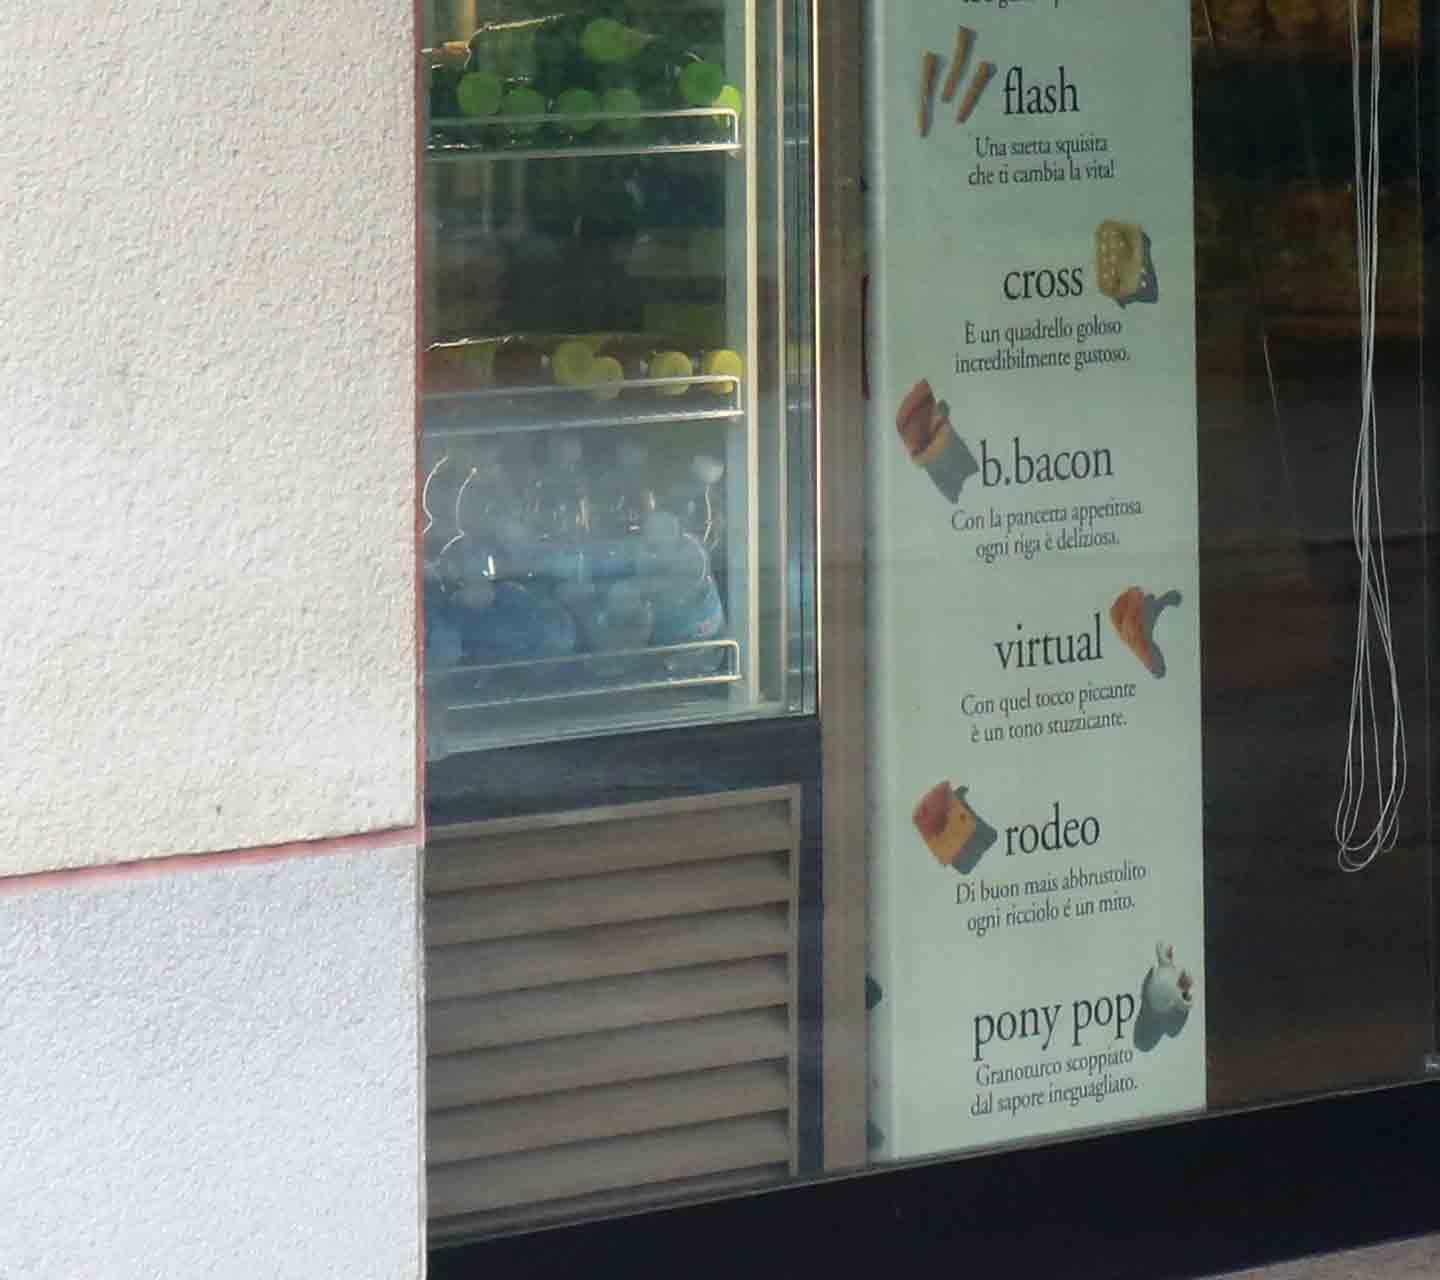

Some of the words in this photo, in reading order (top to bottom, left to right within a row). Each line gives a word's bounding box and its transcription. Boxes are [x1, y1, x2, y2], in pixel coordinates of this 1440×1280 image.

[1003, 65, 1080, 115] flash
[975, 137, 1007, 158] Una
[1056, 133, 1108, 159] squisita
[968, 164, 995, 186] che
[999, 164, 1009, 184] ti
[1013, 162, 1065, 184] cambia
[1069, 160, 1081, 181] la
[1003, 267, 1083, 301] cross
[980, 327, 1000, 344] un
[1005, 315, 1073, 347] quadrello
[1076, 315, 1122, 343] goloso
[955, 346, 1071, 374] incredibilmente
[981, 437, 1114, 488] b.bacon
[951, 509, 984, 532] Con
[990, 508, 1001, 529] la
[1006, 505, 1067, 534] pancetta
[1071, 497, 1143, 528] appetitosa
[975, 536, 1009, 564] ogni
[1013, 534, 1041, 560] riga
[994, 612, 1104, 670] virtual
[961, 694, 994, 716] Con
[999, 688, 1031, 718] quel
[1036, 690, 1074, 708] tocco
[1079, 680, 1137, 713] piccante
[984, 726, 1003, 742] un
[1009, 722, 1043, 739] tono
[1005, 801, 1101, 856] rodeo
[956, 882, 975, 904] Di
[981, 880, 1019, 902] buon
[1062, 859, 1147, 890] abbrustolito
[967, 907, 1000, 937] ogni
[1006, 899, 1059, 927] ricciolo
[1075, 901, 1094, 916] un
[973, 1000, 1062, 1062] pony
[1071, 992, 1135, 1047] pop
[976, 1059, 1062, 1087] Granoturco
[1066, 1045, 1133, 1076] scoppiato
[971, 1092, 992, 1117] dal
[998, 1092, 1044, 1117] sapore
